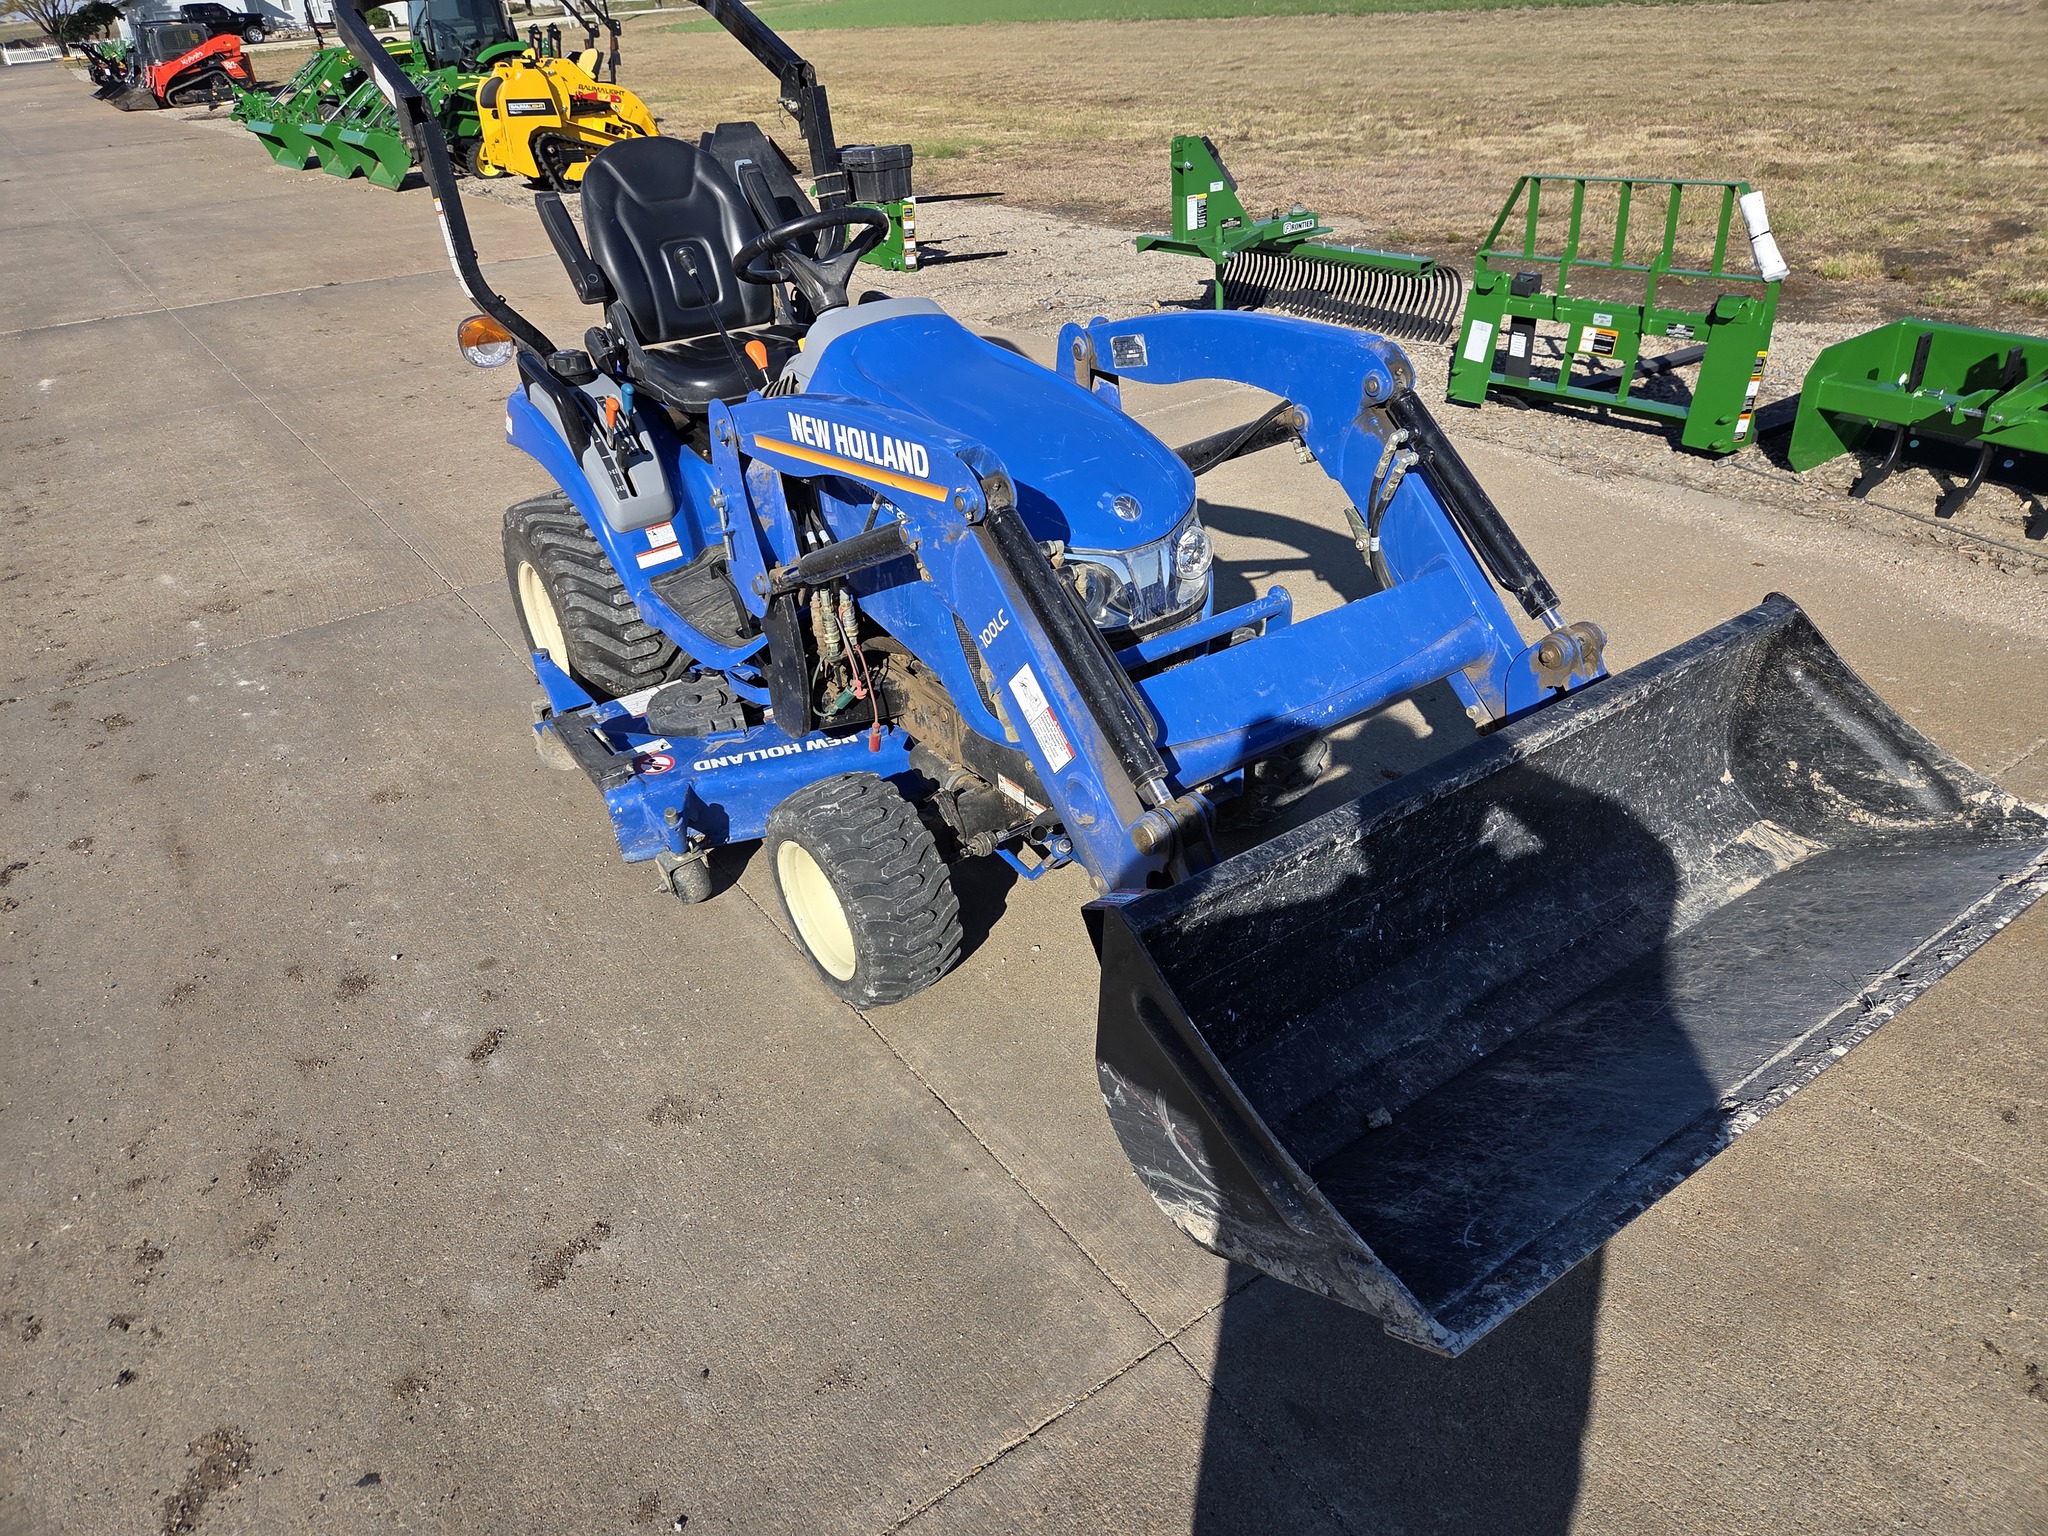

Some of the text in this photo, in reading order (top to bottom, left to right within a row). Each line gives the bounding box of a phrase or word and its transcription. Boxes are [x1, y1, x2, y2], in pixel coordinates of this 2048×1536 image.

[787, 411, 930, 479] NEW HOLLAND
[978, 608, 1009, 649] 100LC
[693, 743, 803, 772] HOLLAND
